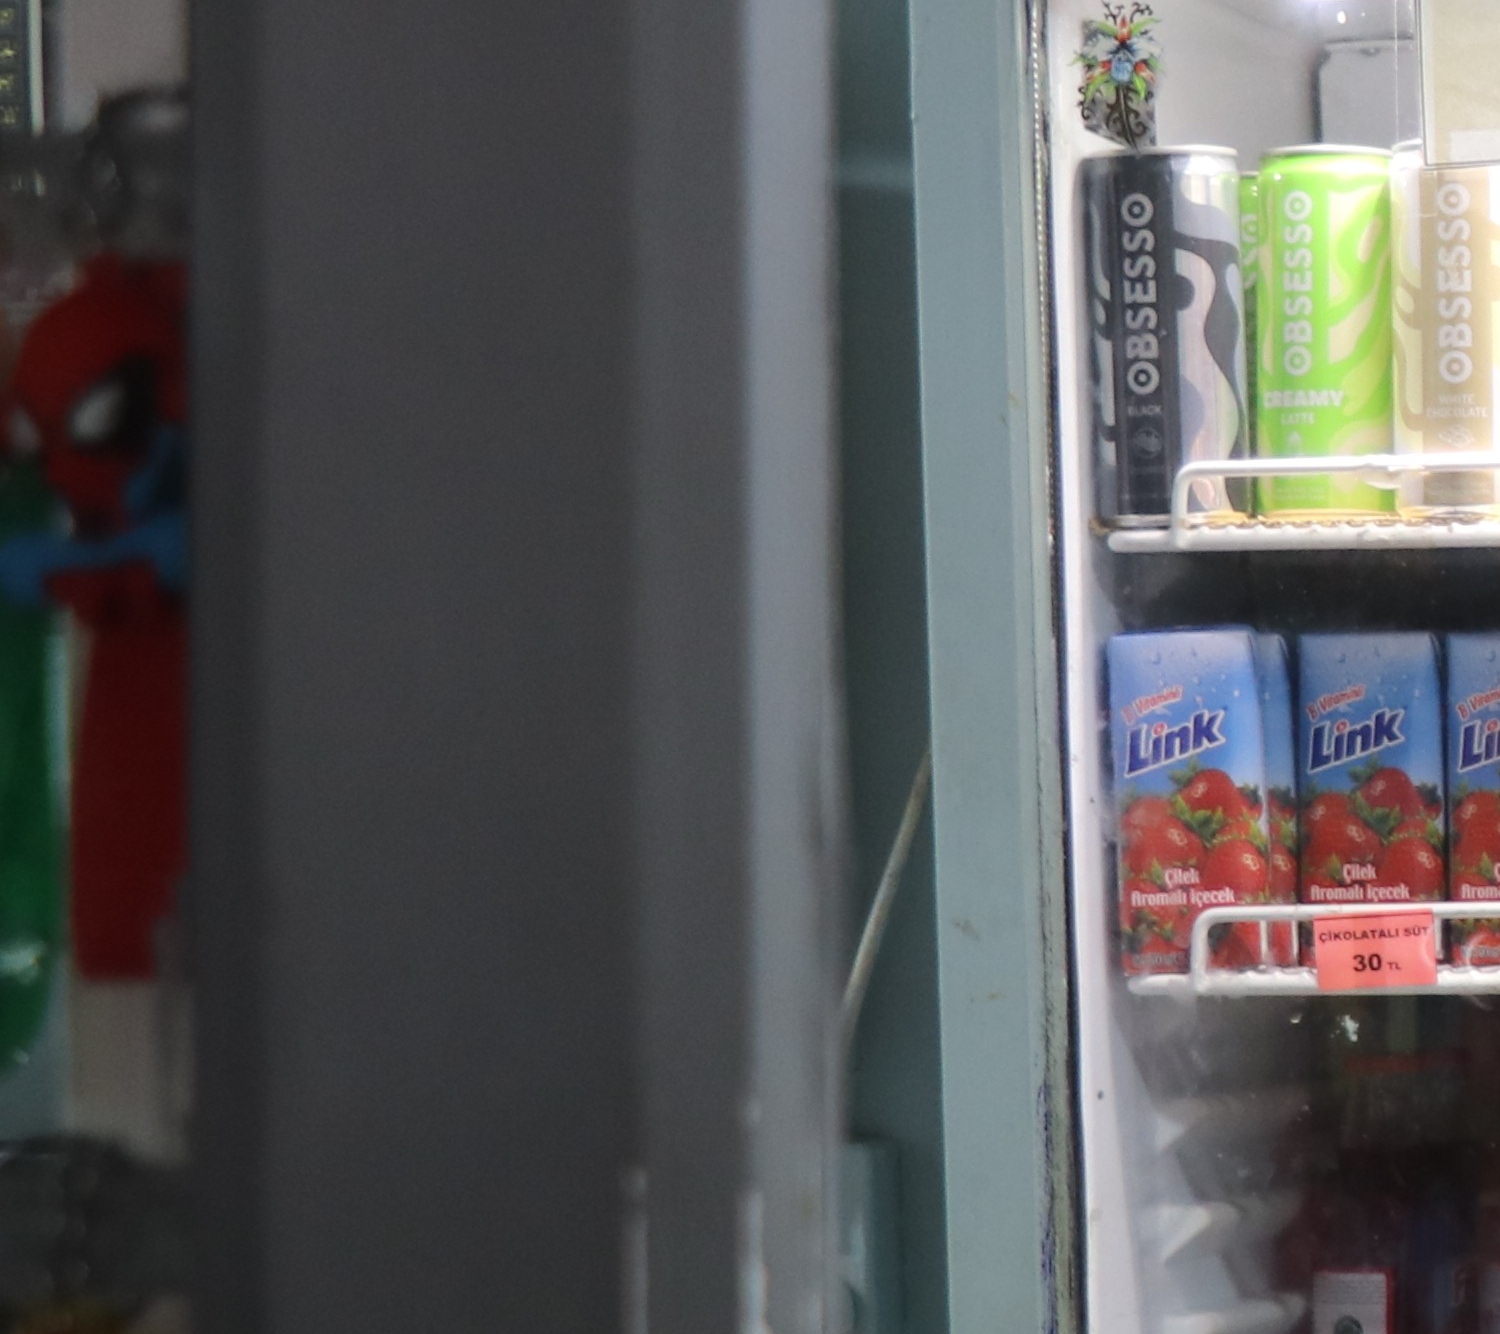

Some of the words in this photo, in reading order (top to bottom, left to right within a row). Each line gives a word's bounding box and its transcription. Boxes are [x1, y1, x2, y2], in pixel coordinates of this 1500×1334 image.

[1284, 190, 1312, 376] OBSESSO
[1437, 182, 1472, 384] OBSESSO
[1121, 193, 1160, 395] OBSESSO
[1264, 390, 1344, 407] CREAMY
[1439, 395, 1475, 405] WHITE
[1126, 709, 1226, 777] Link
[1308, 707, 1405, 774] Link
[1164, 868, 1200, 889] Çilek
[1343, 864, 1376, 883] Çilek
[1132, 889, 1186, 907] Aromalı
[1311, 885, 1364, 901] Aromalı
[1319, 928, 1396, 942] ÇİKOLATALI
[1399, 923, 1429, 937] SÜT
[1353, 954, 1382, 971] 30
[1387, 962, 1401, 971] TL
